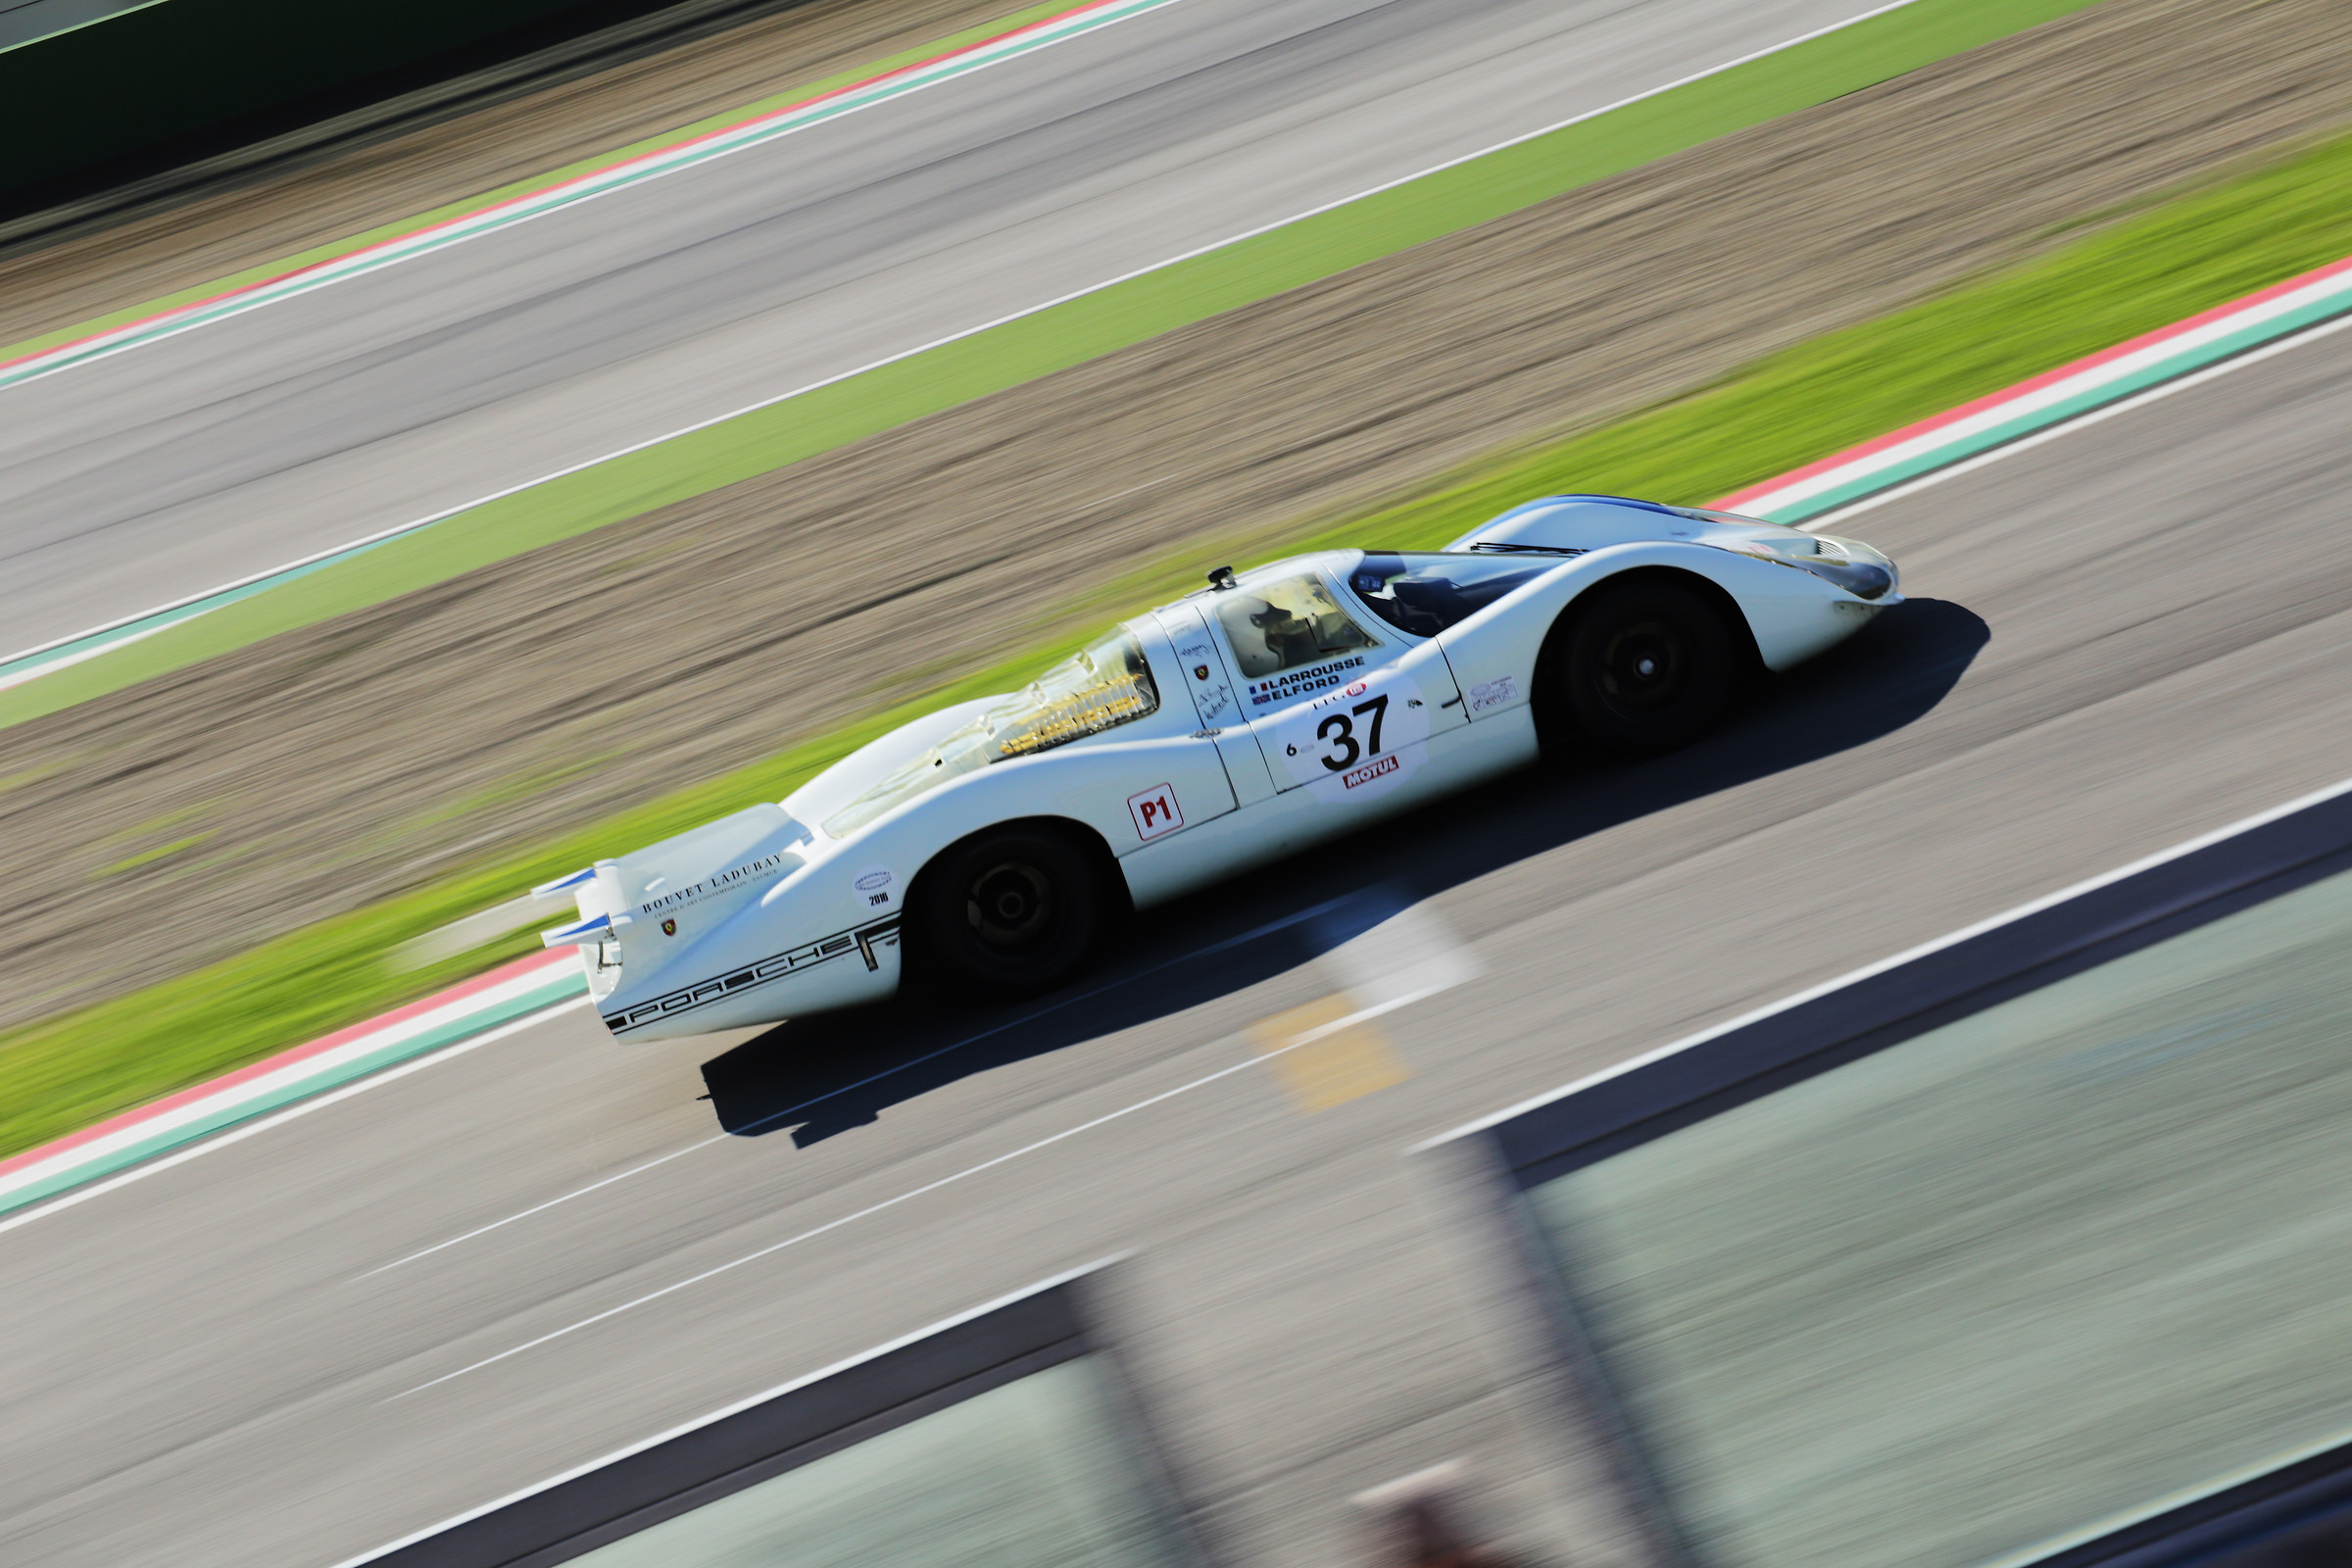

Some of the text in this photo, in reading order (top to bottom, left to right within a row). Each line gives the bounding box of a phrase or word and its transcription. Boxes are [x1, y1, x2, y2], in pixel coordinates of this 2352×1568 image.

[1268, 656, 1365, 689] LARROUSSE
[1272, 675, 1340, 701] ELFORD
[1317, 694, 1389, 772] 37
[1286, 743, 1298, 757] 6
[1347, 758, 1397, 788] MOTUL
[1140, 795, 1172, 828] P1
[642, 853, 782, 914] BOUVET LADUBAY
[629, 935, 853, 1023] PORSCHE
